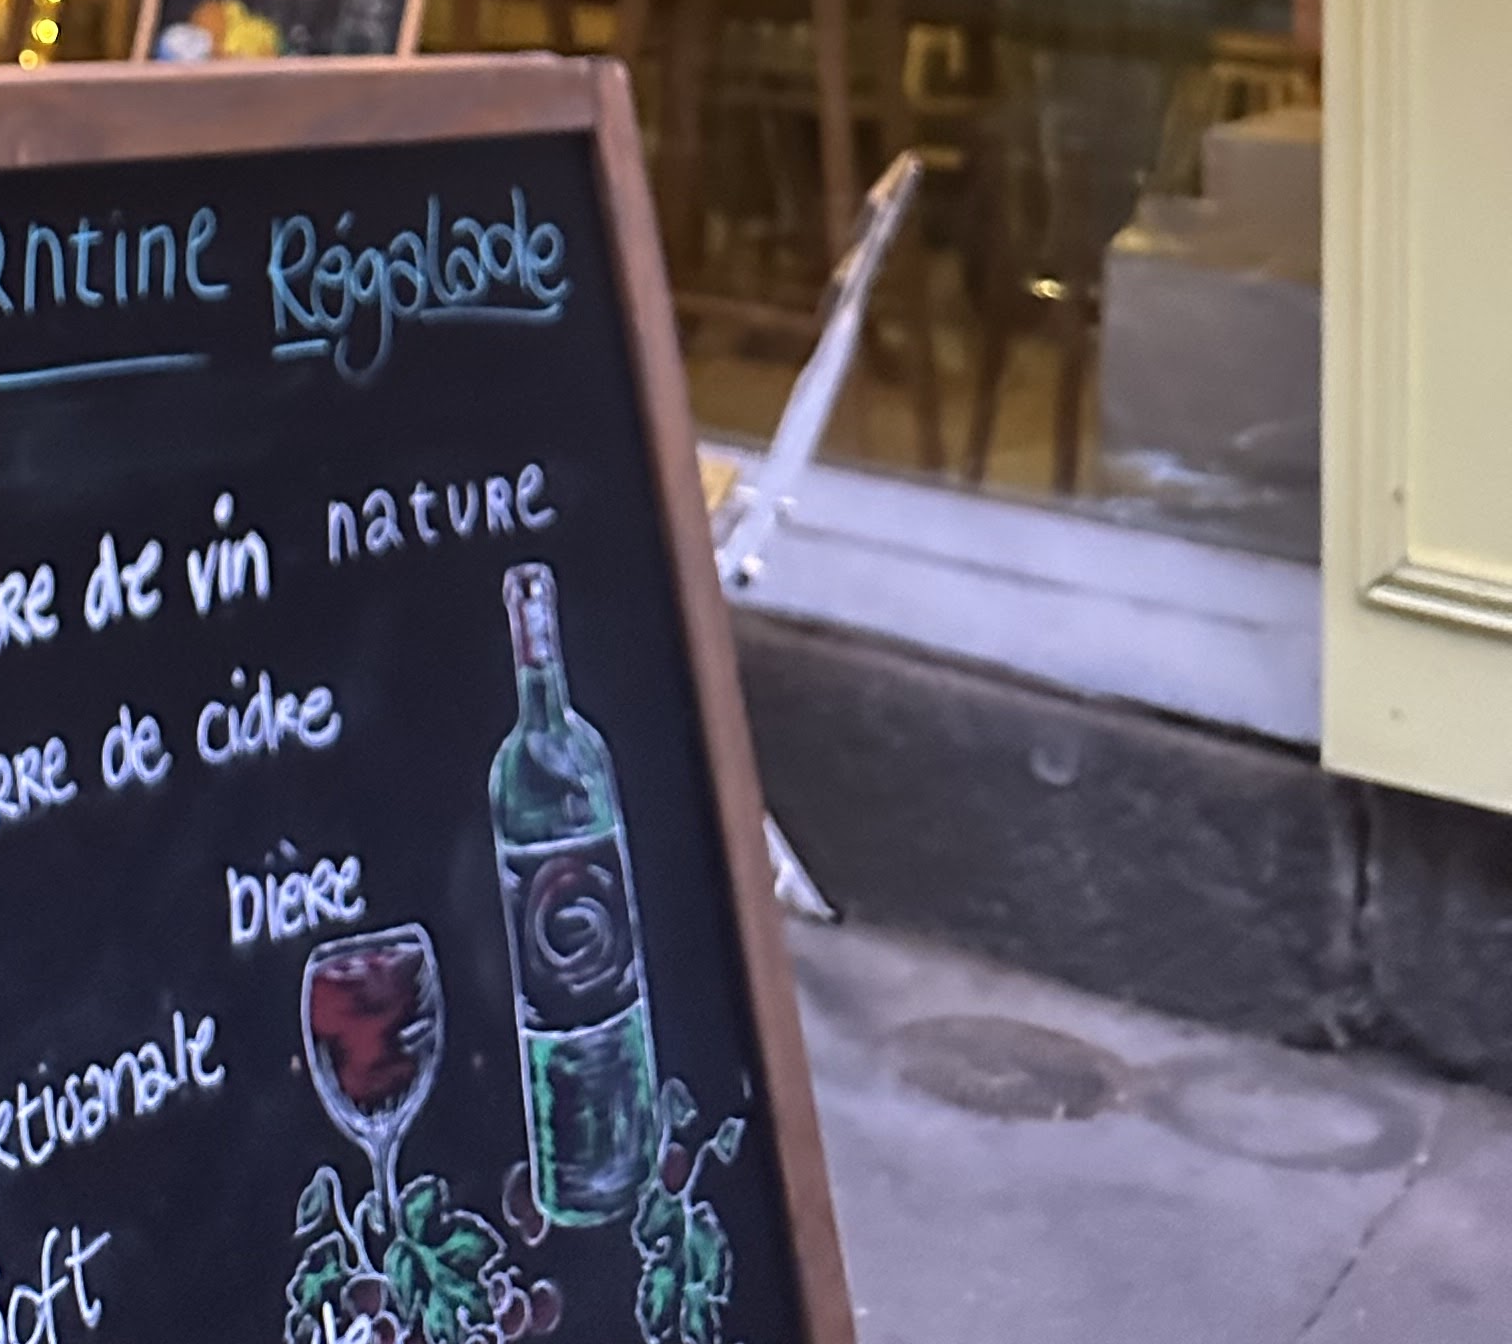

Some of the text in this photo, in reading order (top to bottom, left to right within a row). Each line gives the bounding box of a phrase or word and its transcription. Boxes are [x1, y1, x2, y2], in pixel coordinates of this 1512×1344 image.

[266, 184, 572, 386] Régalade
[82, 529, 164, 631] de
[187, 490, 270, 617] vin
[100, 702, 173, 791] de
